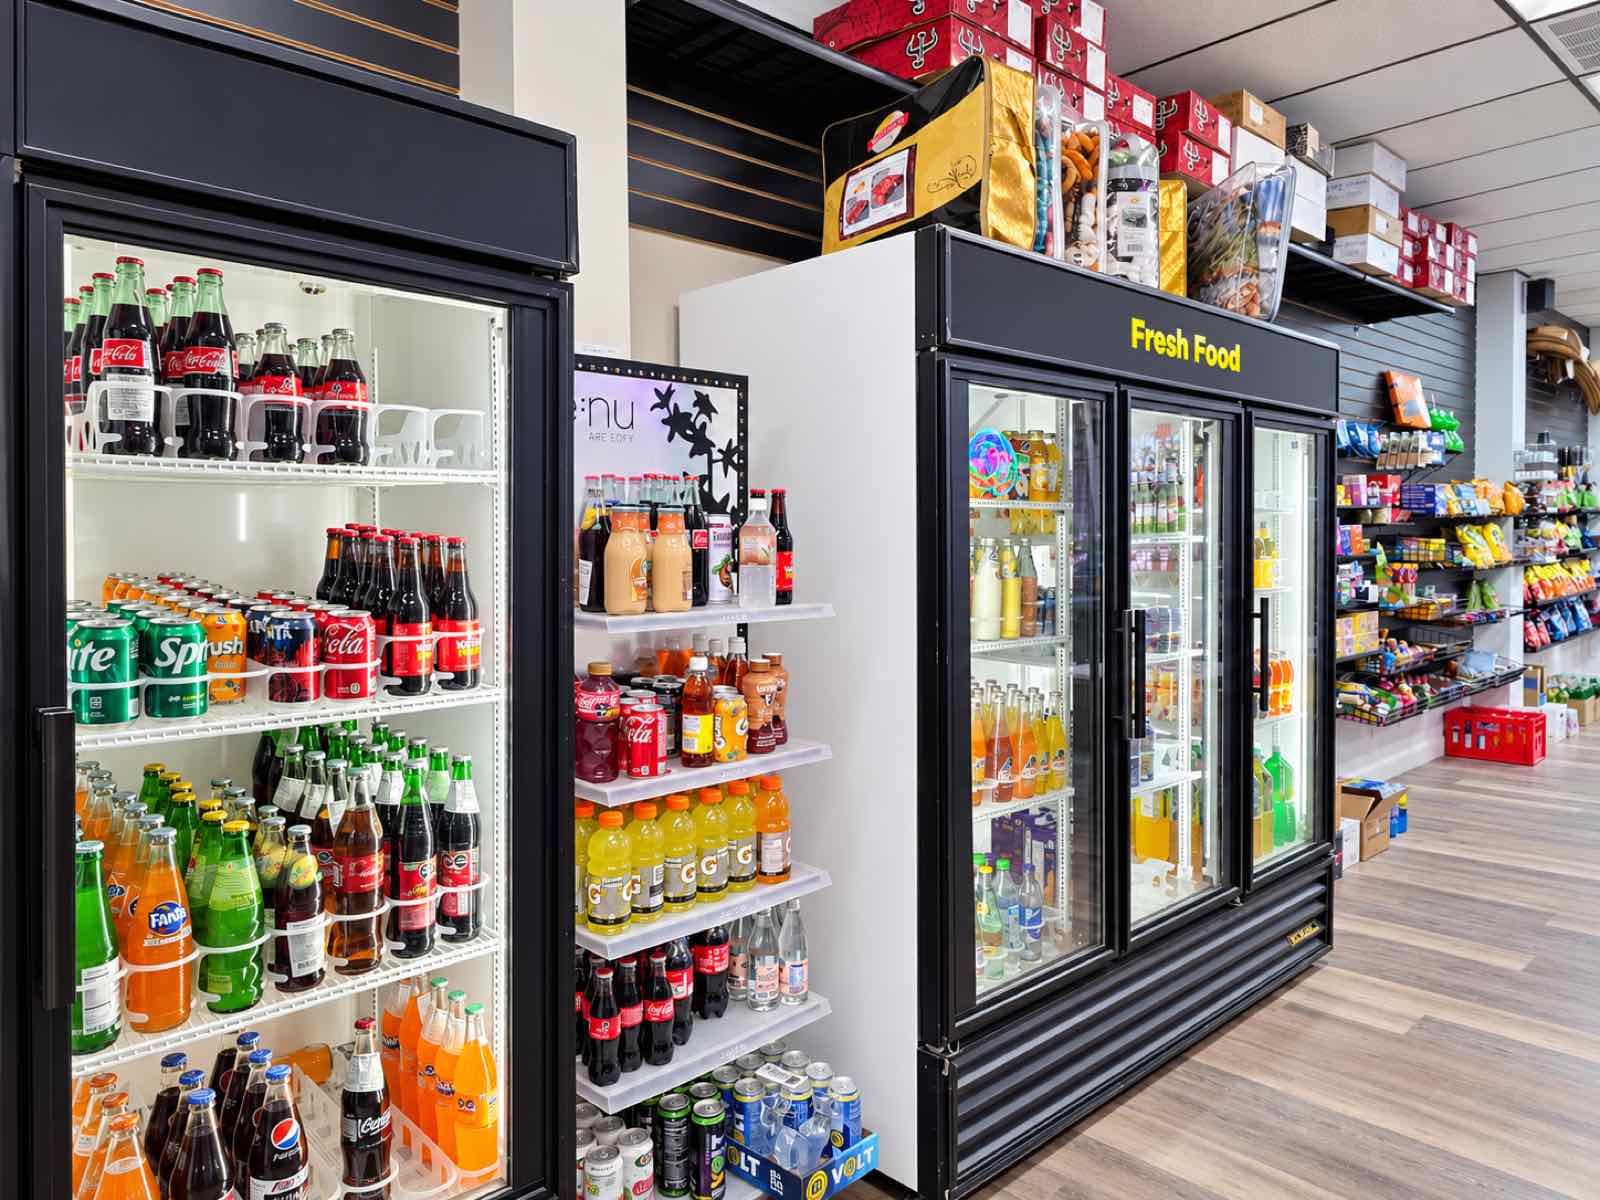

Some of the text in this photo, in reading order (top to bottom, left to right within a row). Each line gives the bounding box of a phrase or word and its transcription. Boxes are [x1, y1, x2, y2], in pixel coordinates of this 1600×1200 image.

[1130, 317, 1242, 373] Fresh Food
[71, 639, 116, 672] ite
[207, 636, 244, 656] rush
[727, 1145, 761, 1177] OLT
